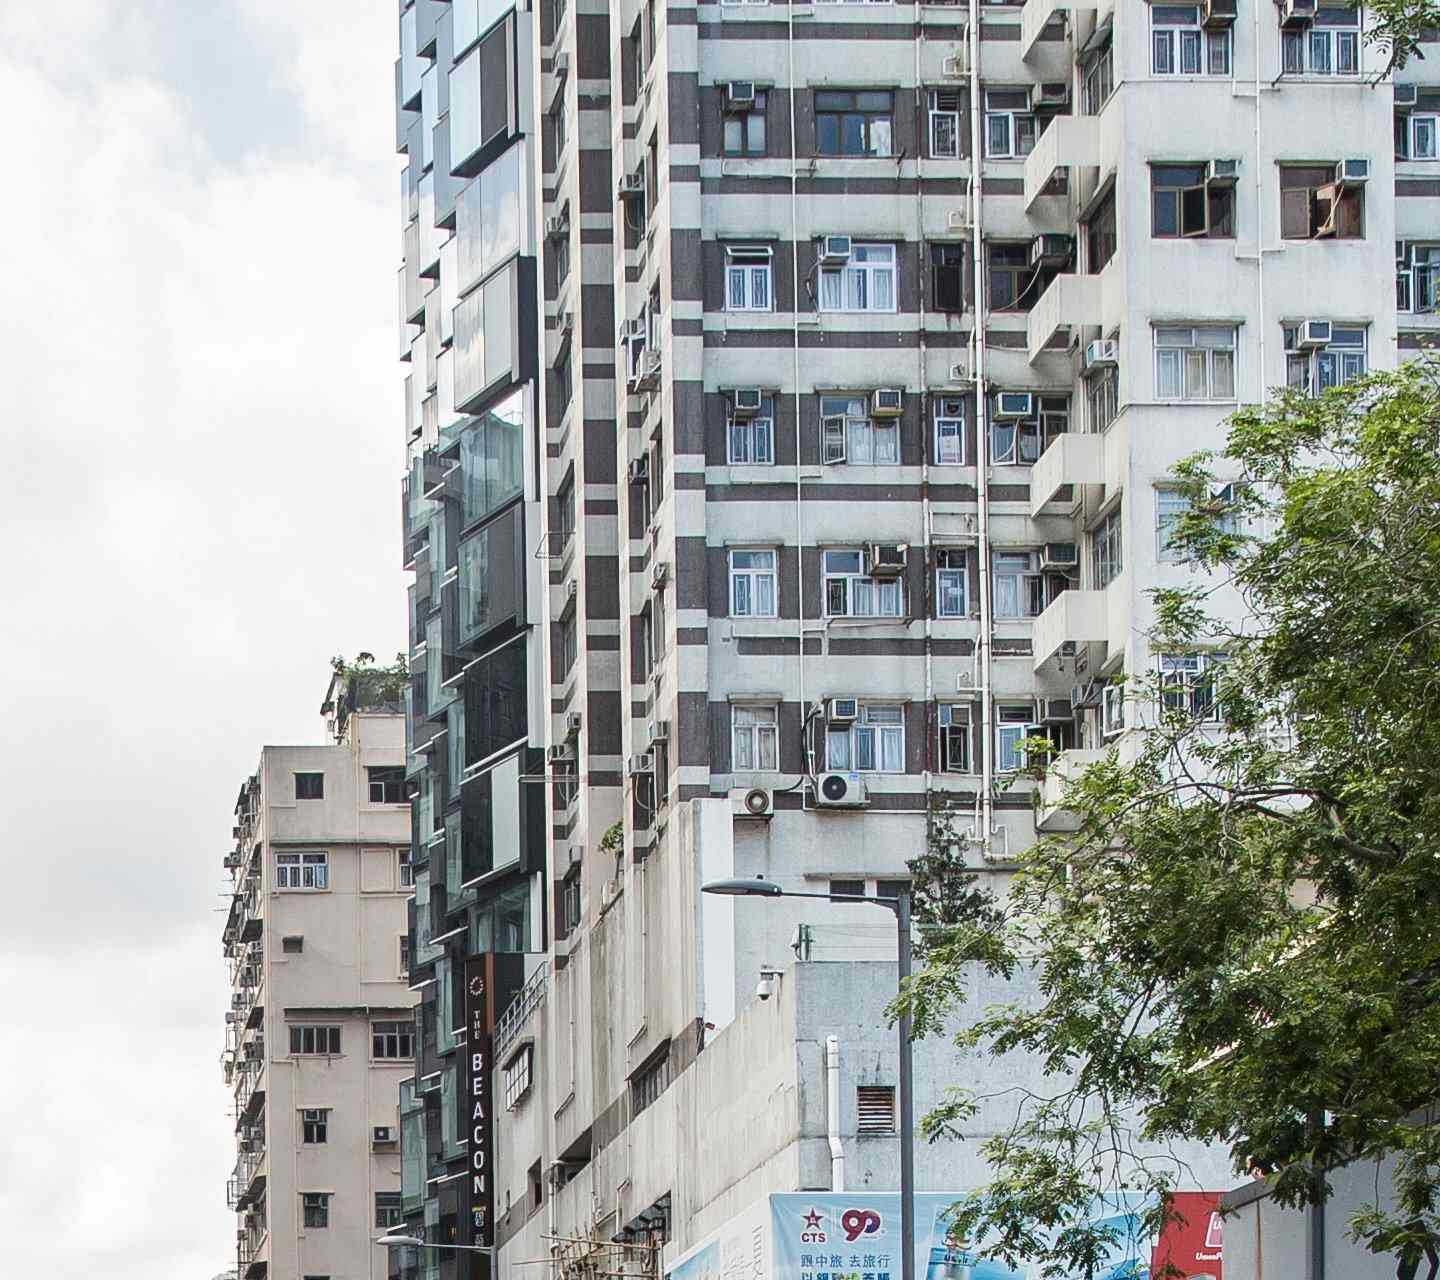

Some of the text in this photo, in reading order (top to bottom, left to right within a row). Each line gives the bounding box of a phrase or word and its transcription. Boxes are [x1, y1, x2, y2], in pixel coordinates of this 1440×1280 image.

[473, 1010, 481, 1040] THE
[472, 1053, 485, 1194] BEACON
[801, 1233, 825, 1243] CTS
[849, 1254, 891, 1268] 去旅行
